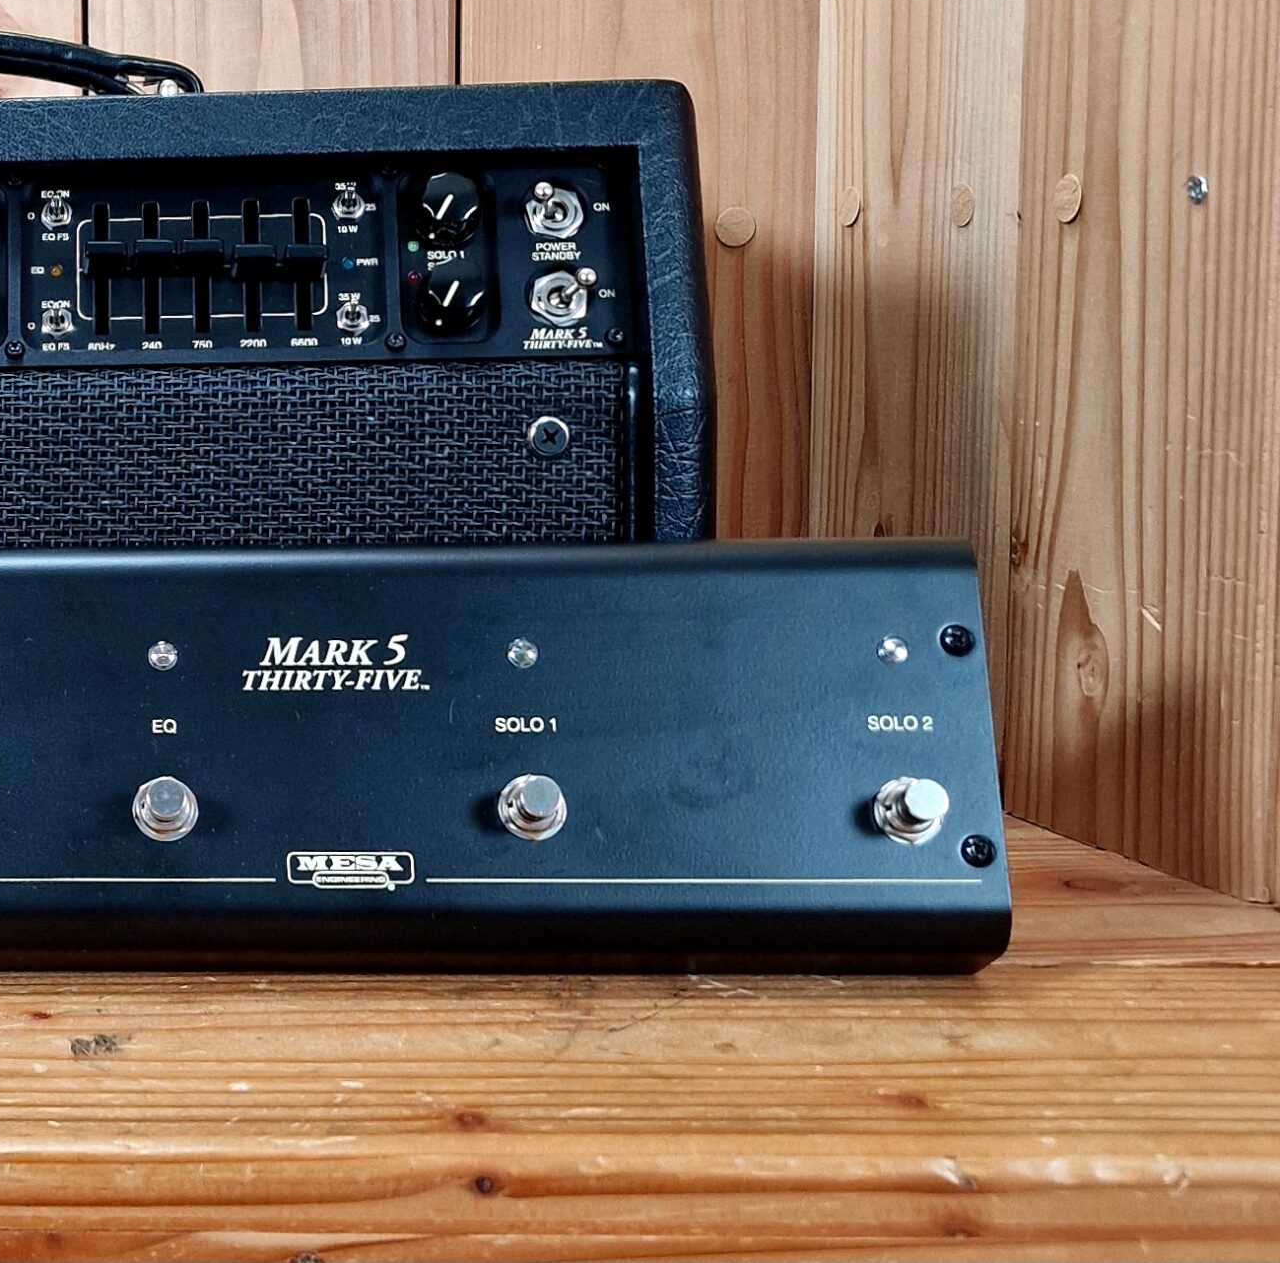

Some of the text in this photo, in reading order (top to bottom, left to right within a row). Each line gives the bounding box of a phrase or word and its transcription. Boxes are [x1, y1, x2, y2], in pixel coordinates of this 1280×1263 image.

[365, 203, 376, 211] 25
[593, 202, 610, 212] ON
[535, 242, 576, 251] POWER
[531, 251, 581, 261] STANDBY
[356, 258, 378, 267] PWR
[598, 289, 615, 298] ON
[530, 328, 575, 339] MARK
[259, 634, 409, 667] MARK 5
[151, 718, 177, 734] EQ
[494, 717, 558, 733] SOLO 1
[867, 715, 934, 732] SOLO 2
[296, 855, 404, 872] MESA
